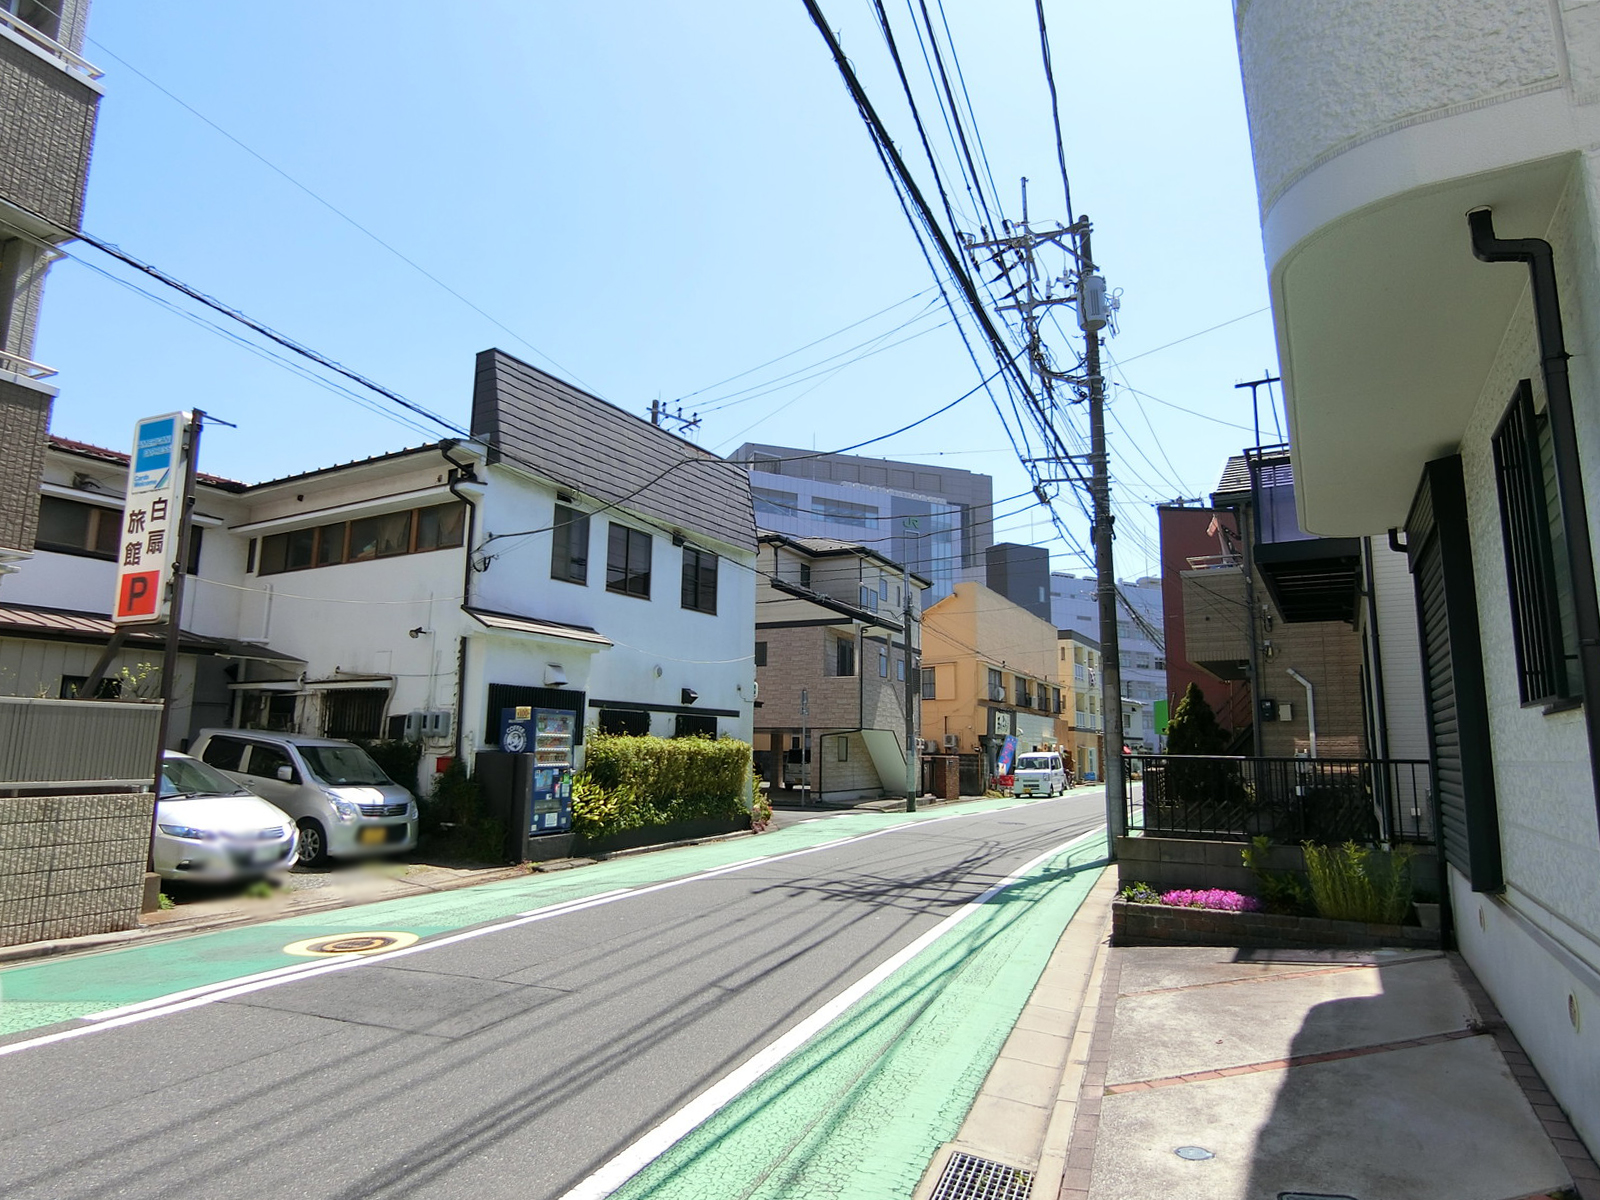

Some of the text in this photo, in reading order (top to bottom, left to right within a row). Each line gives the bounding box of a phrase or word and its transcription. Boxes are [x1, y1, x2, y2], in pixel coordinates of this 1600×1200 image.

[123, 509, 146, 566] 旅館
[146, 497, 168, 554] 白扇
[902, 516, 919, 529] JR
[127, 576, 147, 611] P
[506, 725, 526, 734] COFFEE
